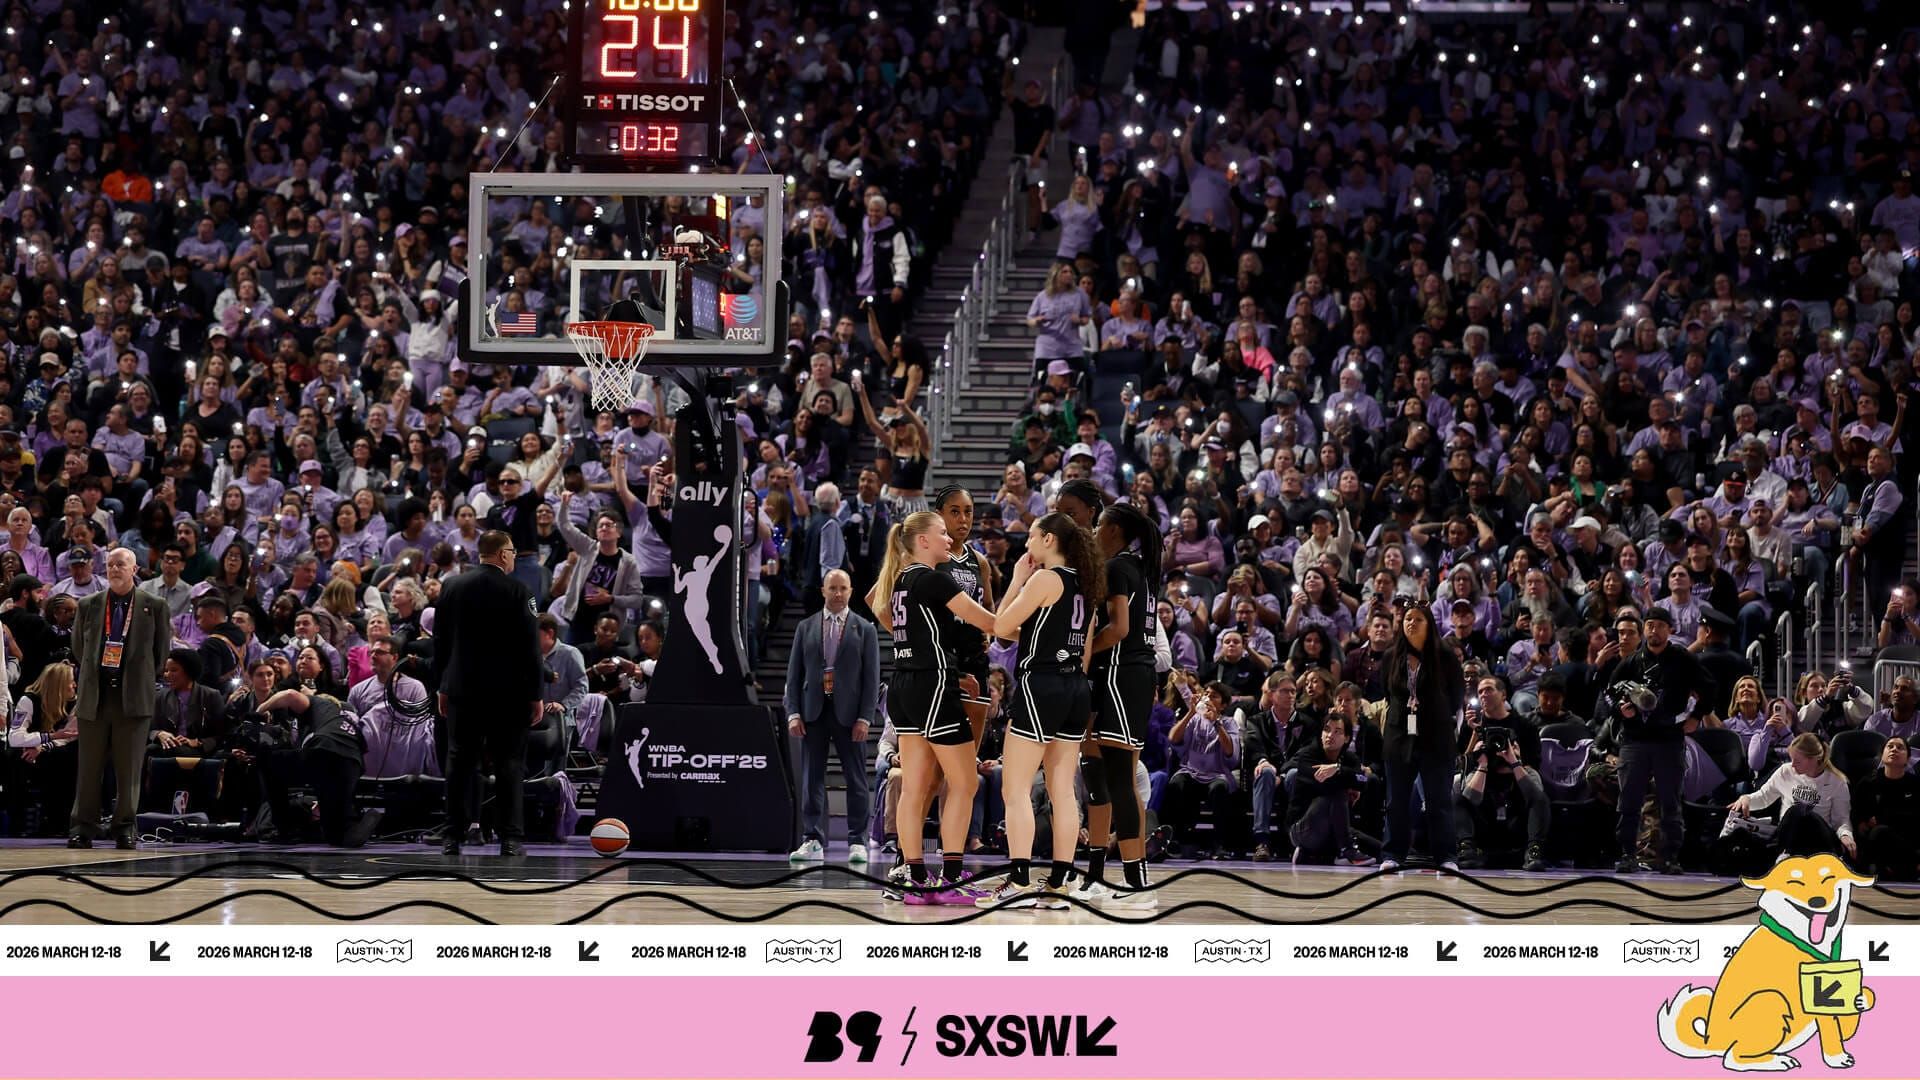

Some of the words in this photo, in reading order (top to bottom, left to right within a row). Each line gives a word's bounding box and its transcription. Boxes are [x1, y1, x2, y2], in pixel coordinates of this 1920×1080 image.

[601, 15, 690, 78] 24
[616, 94, 705, 112] TISSOT
[622, 126, 678, 152] 0:32
[725, 327, 761, 340] AT&T
[680, 481, 728, 507] ally
[892, 590, 908, 627] 35
[1071, 594, 1085, 630] 0
[1067, 632, 1086, 647] LEITE
[648, 744, 686, 753] WNBA
[647, 754, 768, 769] TIP-OFF'25
